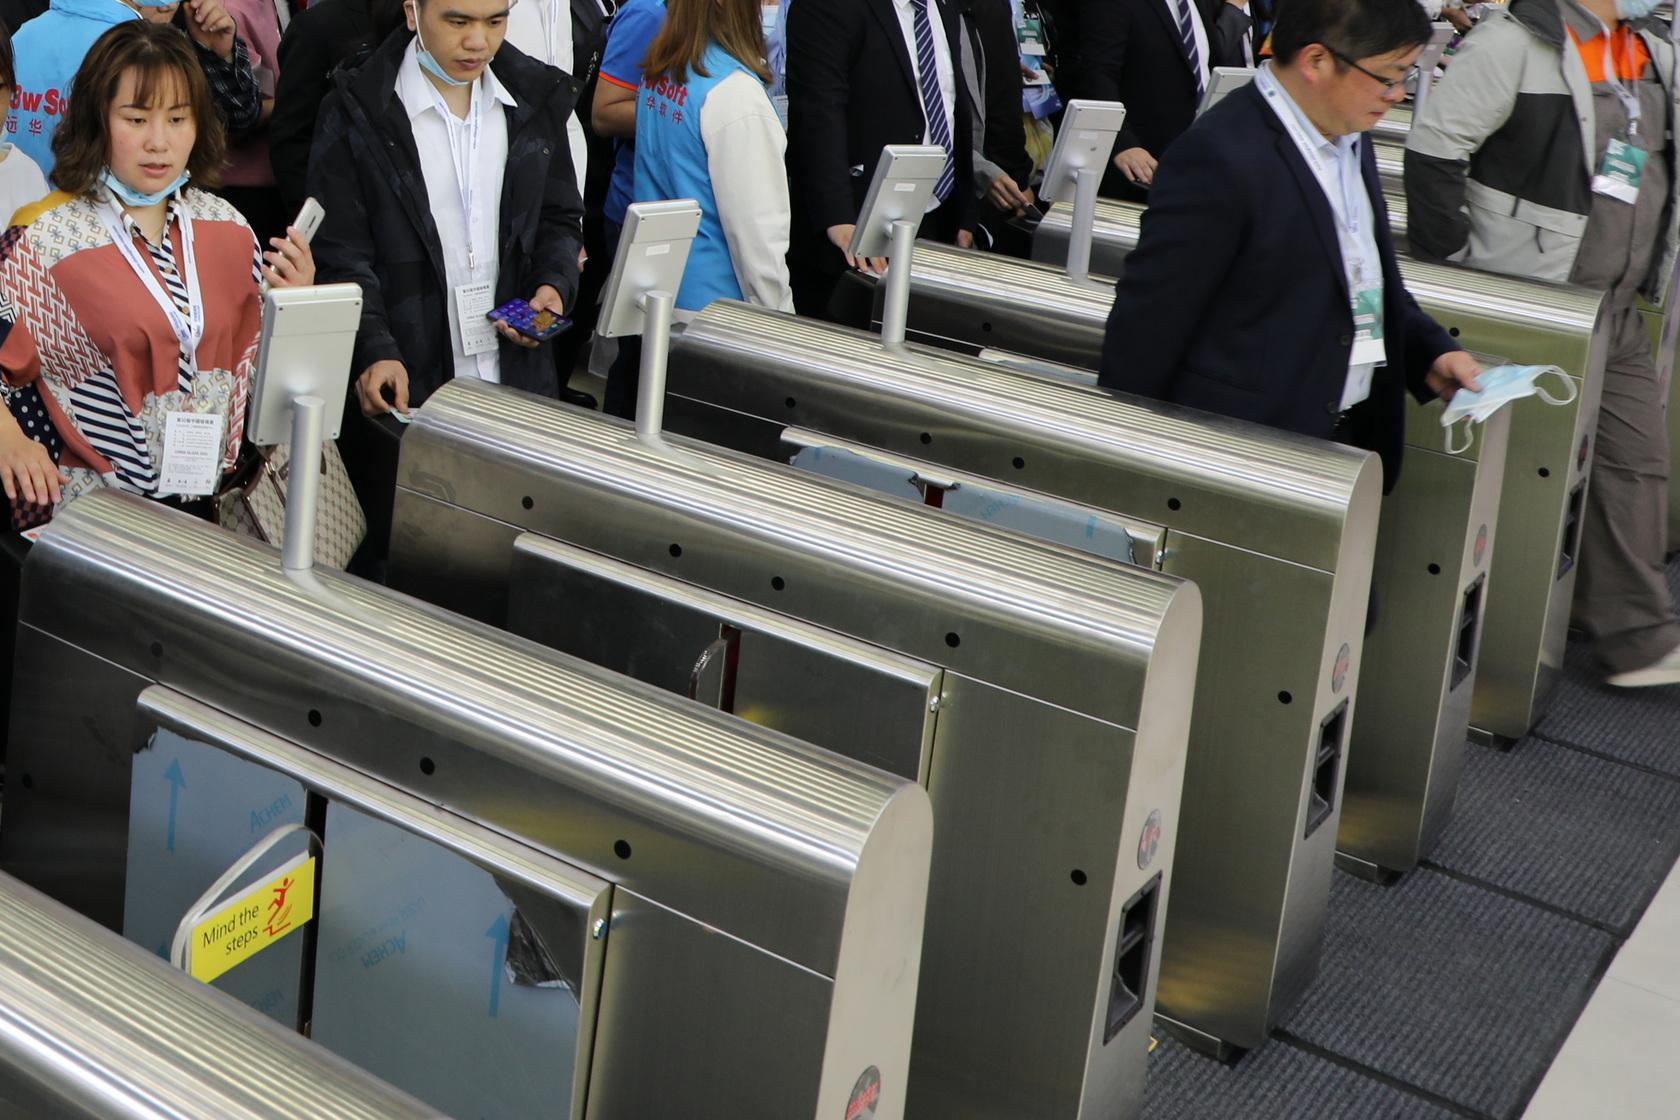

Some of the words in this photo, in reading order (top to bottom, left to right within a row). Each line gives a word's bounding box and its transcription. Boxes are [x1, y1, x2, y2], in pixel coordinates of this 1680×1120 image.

[202, 914, 237, 949] Mind
[239, 904, 260, 927] the
[224, 924, 259, 957] steps
